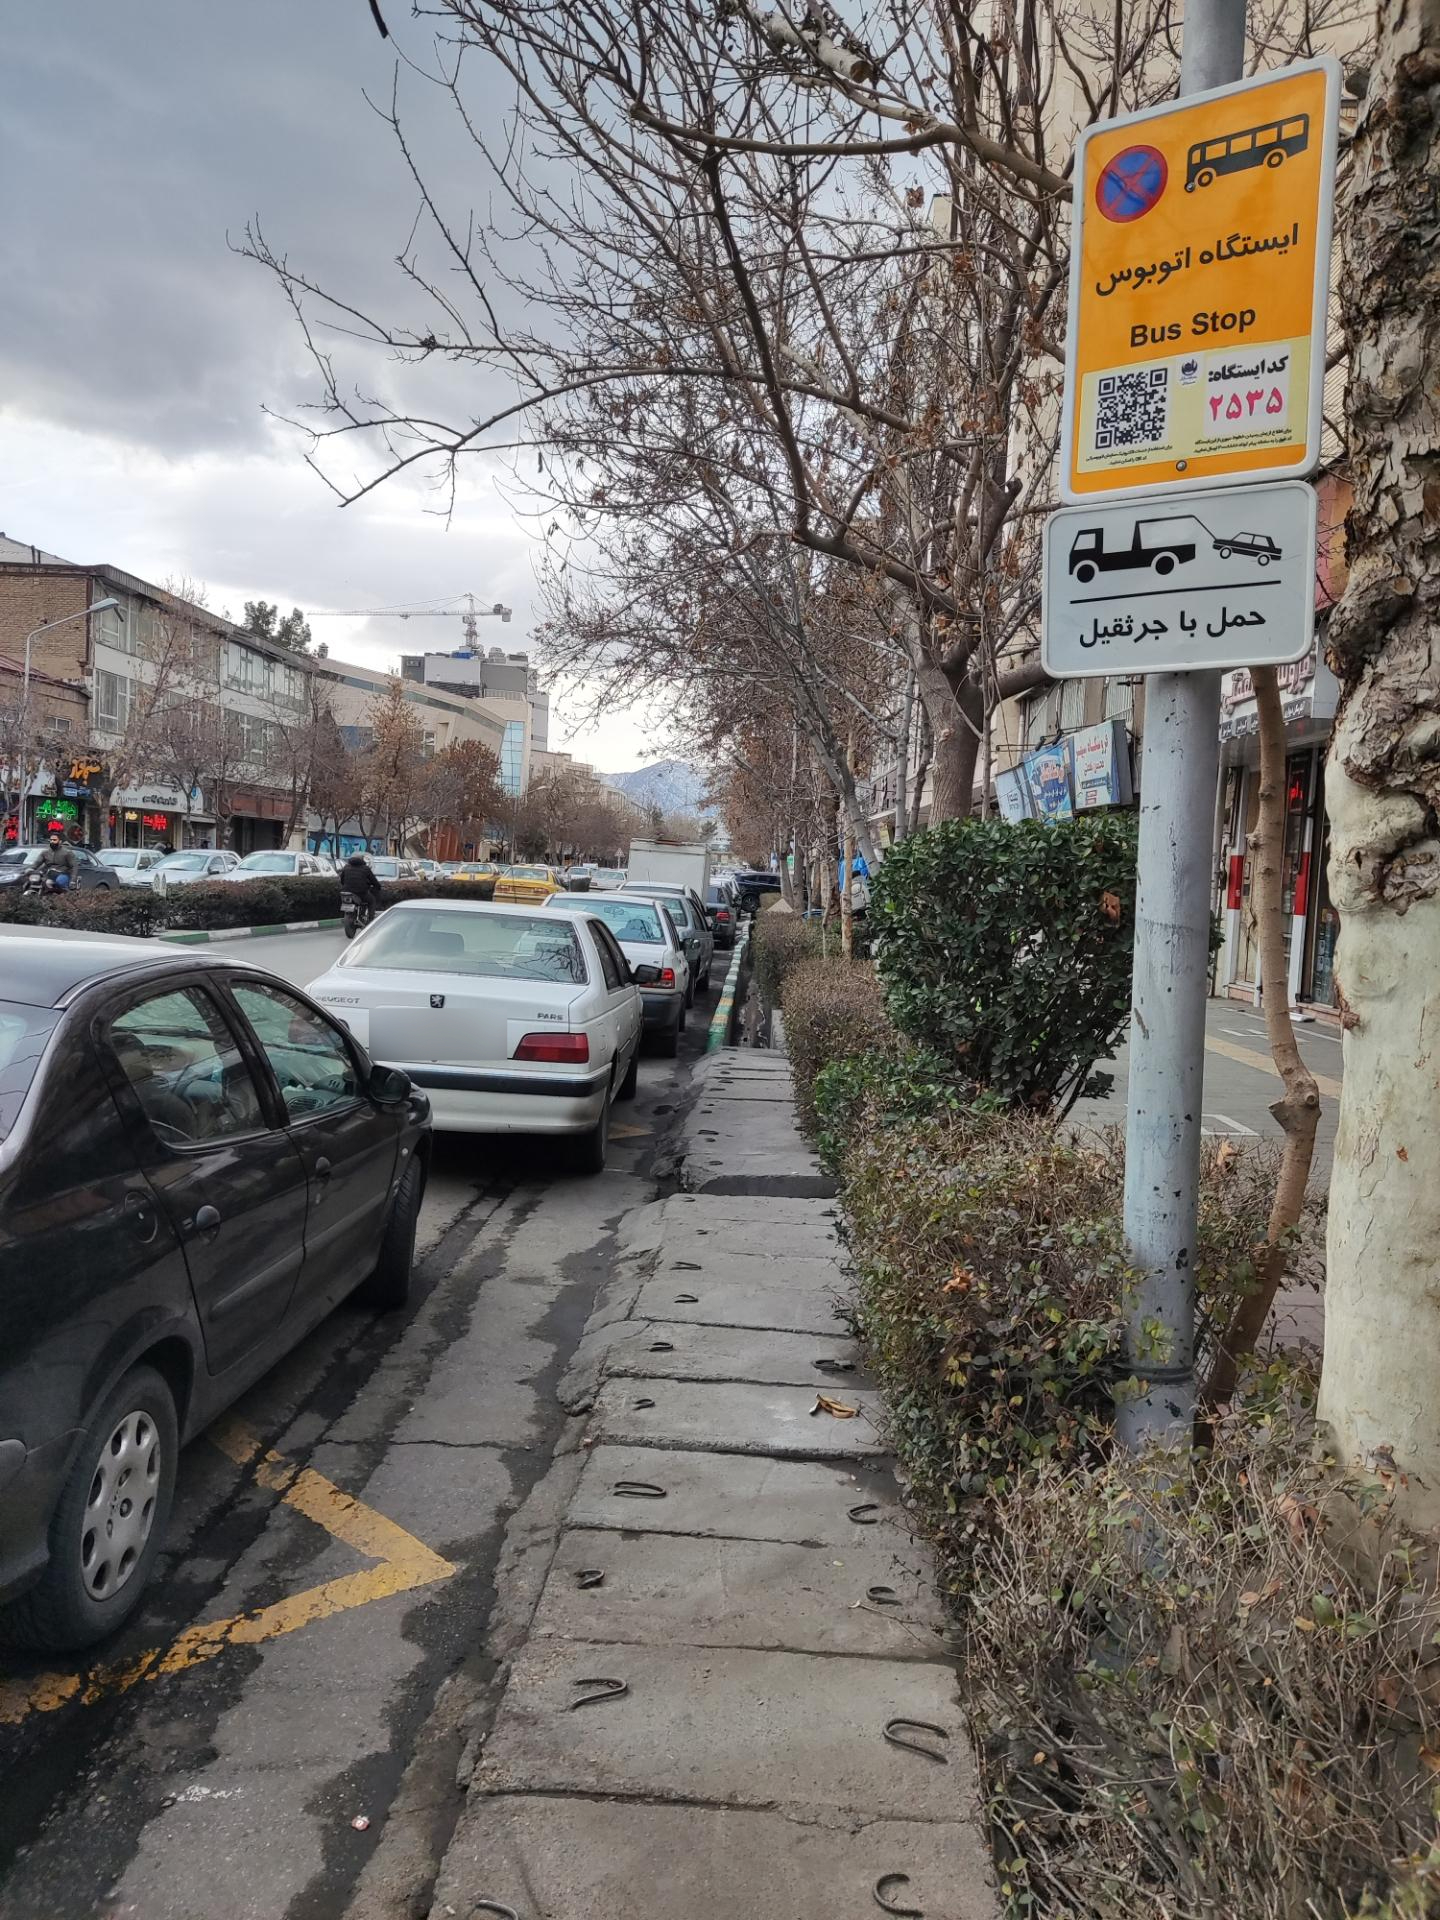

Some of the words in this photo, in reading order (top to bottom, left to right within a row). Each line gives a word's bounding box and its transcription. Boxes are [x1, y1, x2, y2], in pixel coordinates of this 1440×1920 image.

[1199, 223, 1298, 265] ایستگاه
[1095, 247, 1191, 296] اتوبوس
[1130, 321, 1181, 348] Bus
[1192, 308, 1256, 336] Stop
[1267, 355, 1289, 374] کد
[1079, 614, 1169, 648] جرثقیل
[1179, 610, 1197, 637] با
[1206, 606, 1266, 637] حمل
[537, 1012, 563, 1021] PARS
